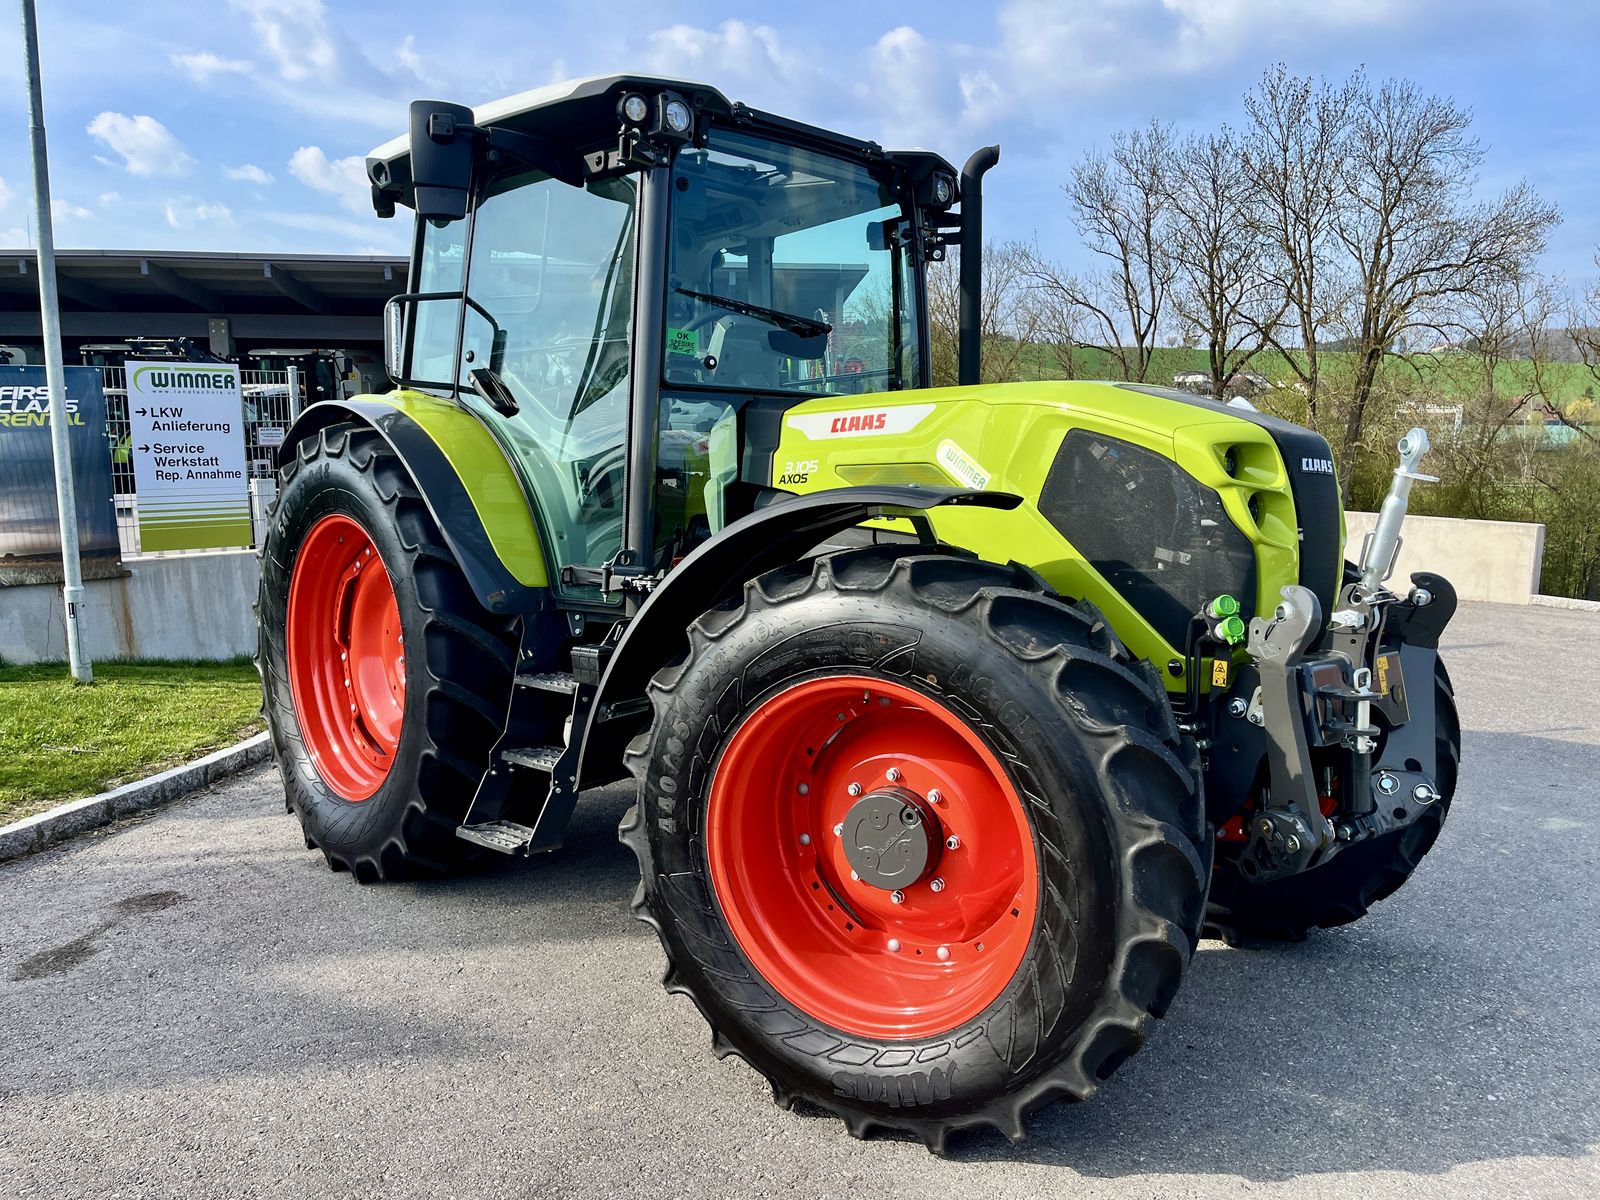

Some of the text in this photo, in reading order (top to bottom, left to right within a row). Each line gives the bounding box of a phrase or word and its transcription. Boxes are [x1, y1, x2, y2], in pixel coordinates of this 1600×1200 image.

[676, 332, 689, 340] OK
[150, 372, 236, 389] WIMMER
[0, 386, 68, 400] FIRS
[150, 407, 183, 418] LKW
[152, 420, 230, 434] Anlieferung
[830, 413, 887, 433] CLAAS
[153, 443, 205, 454] Service
[154, 456, 219, 467] Werkstatt
[783, 459, 819, 475] 3.105
[945, 447, 986, 489] WIMMER
[1302, 457, 1333, 473] CLAAS
[155, 469, 242, 482] Rep. Annahme
[778, 473, 808, 484] AXOS
[831, 1060, 958, 1108] Mitas
